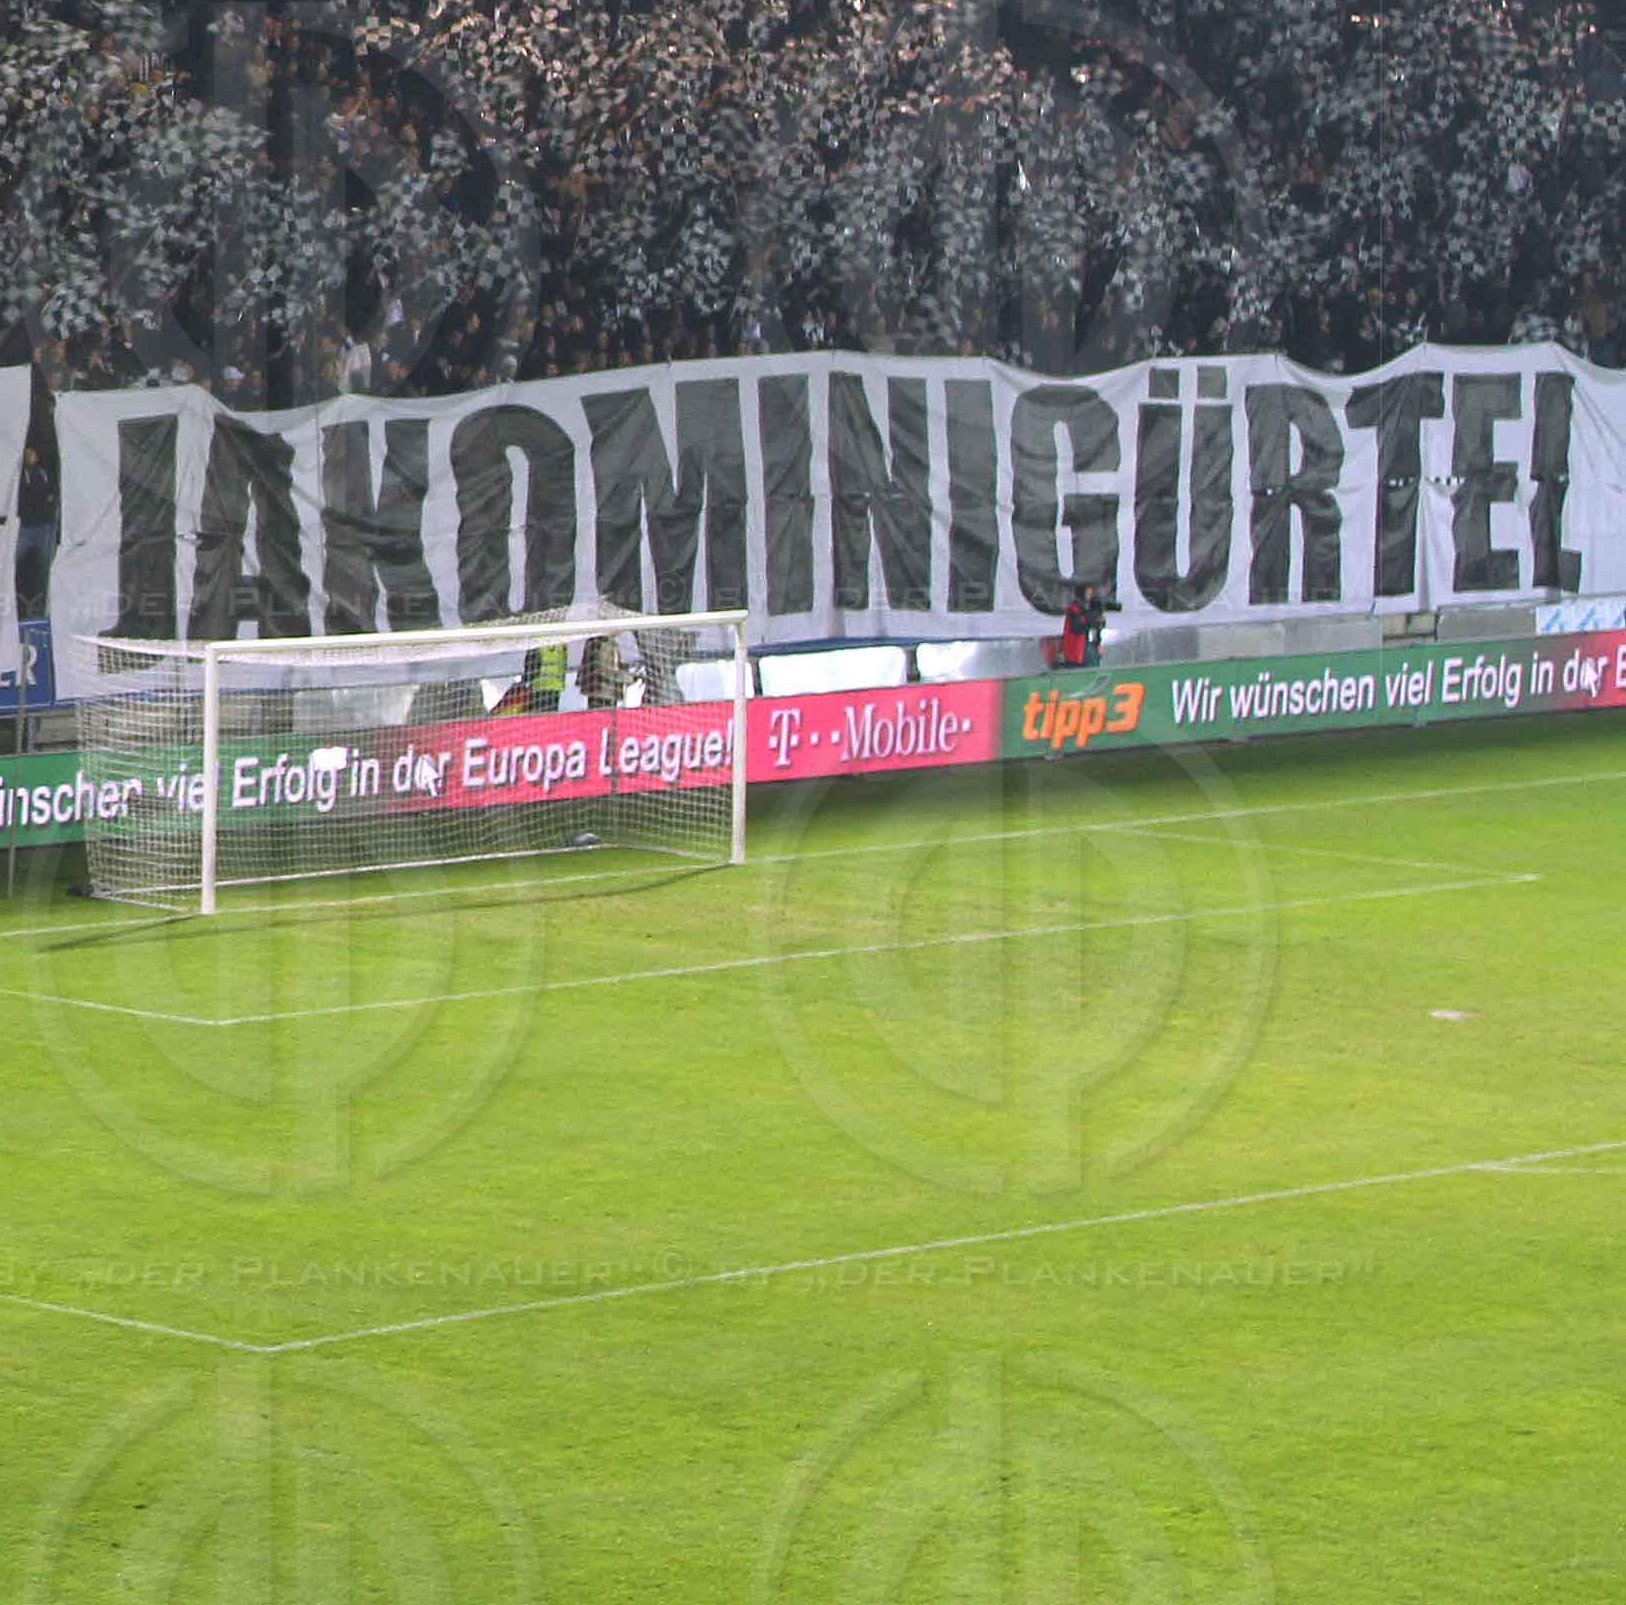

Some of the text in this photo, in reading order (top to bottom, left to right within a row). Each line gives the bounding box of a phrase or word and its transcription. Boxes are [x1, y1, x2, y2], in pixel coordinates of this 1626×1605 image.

[1022, 682, 1146, 751] tipp3
[1170, 677, 1223, 725] Wir
[1229, 667, 1376, 720] wünschen
[1385, 659, 1435, 708] viel
[1442, 653, 1522, 708] Erfolg
[1530, 650, 1554, 694] in
[156, 762, 221, 812] vie
[231, 748, 338, 813] Erfolg
[351, 748, 380, 796] in
[462, 736, 588, 791] Europa
[599, 718, 734, 783] League!
